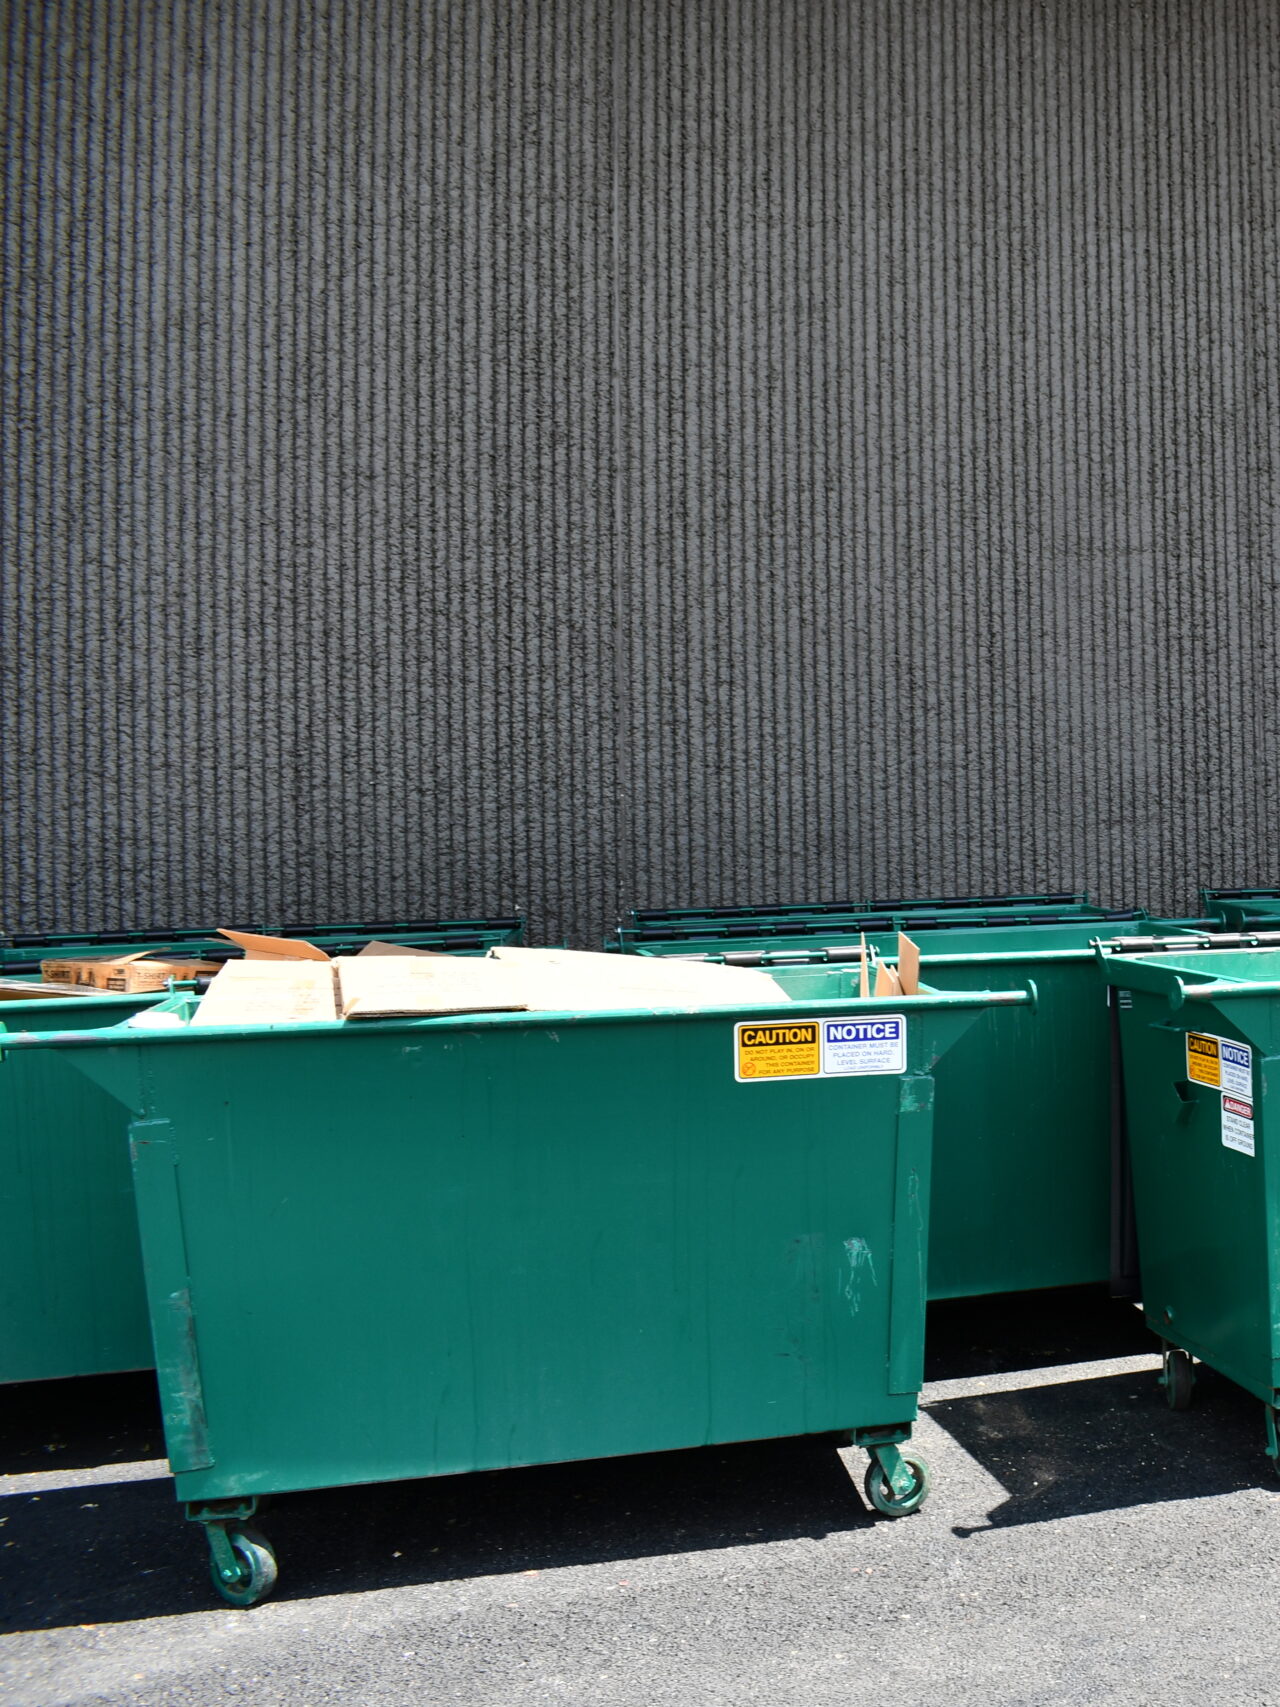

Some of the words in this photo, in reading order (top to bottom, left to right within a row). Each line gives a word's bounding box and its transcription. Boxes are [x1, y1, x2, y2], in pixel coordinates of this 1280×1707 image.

[743, 1028, 813, 1045] CAUTION
[829, 1023, 897, 1041] NOTICE
[1189, 1038, 1217, 1056] CAUTION
[1222, 1045, 1248, 1066] NOTICE
